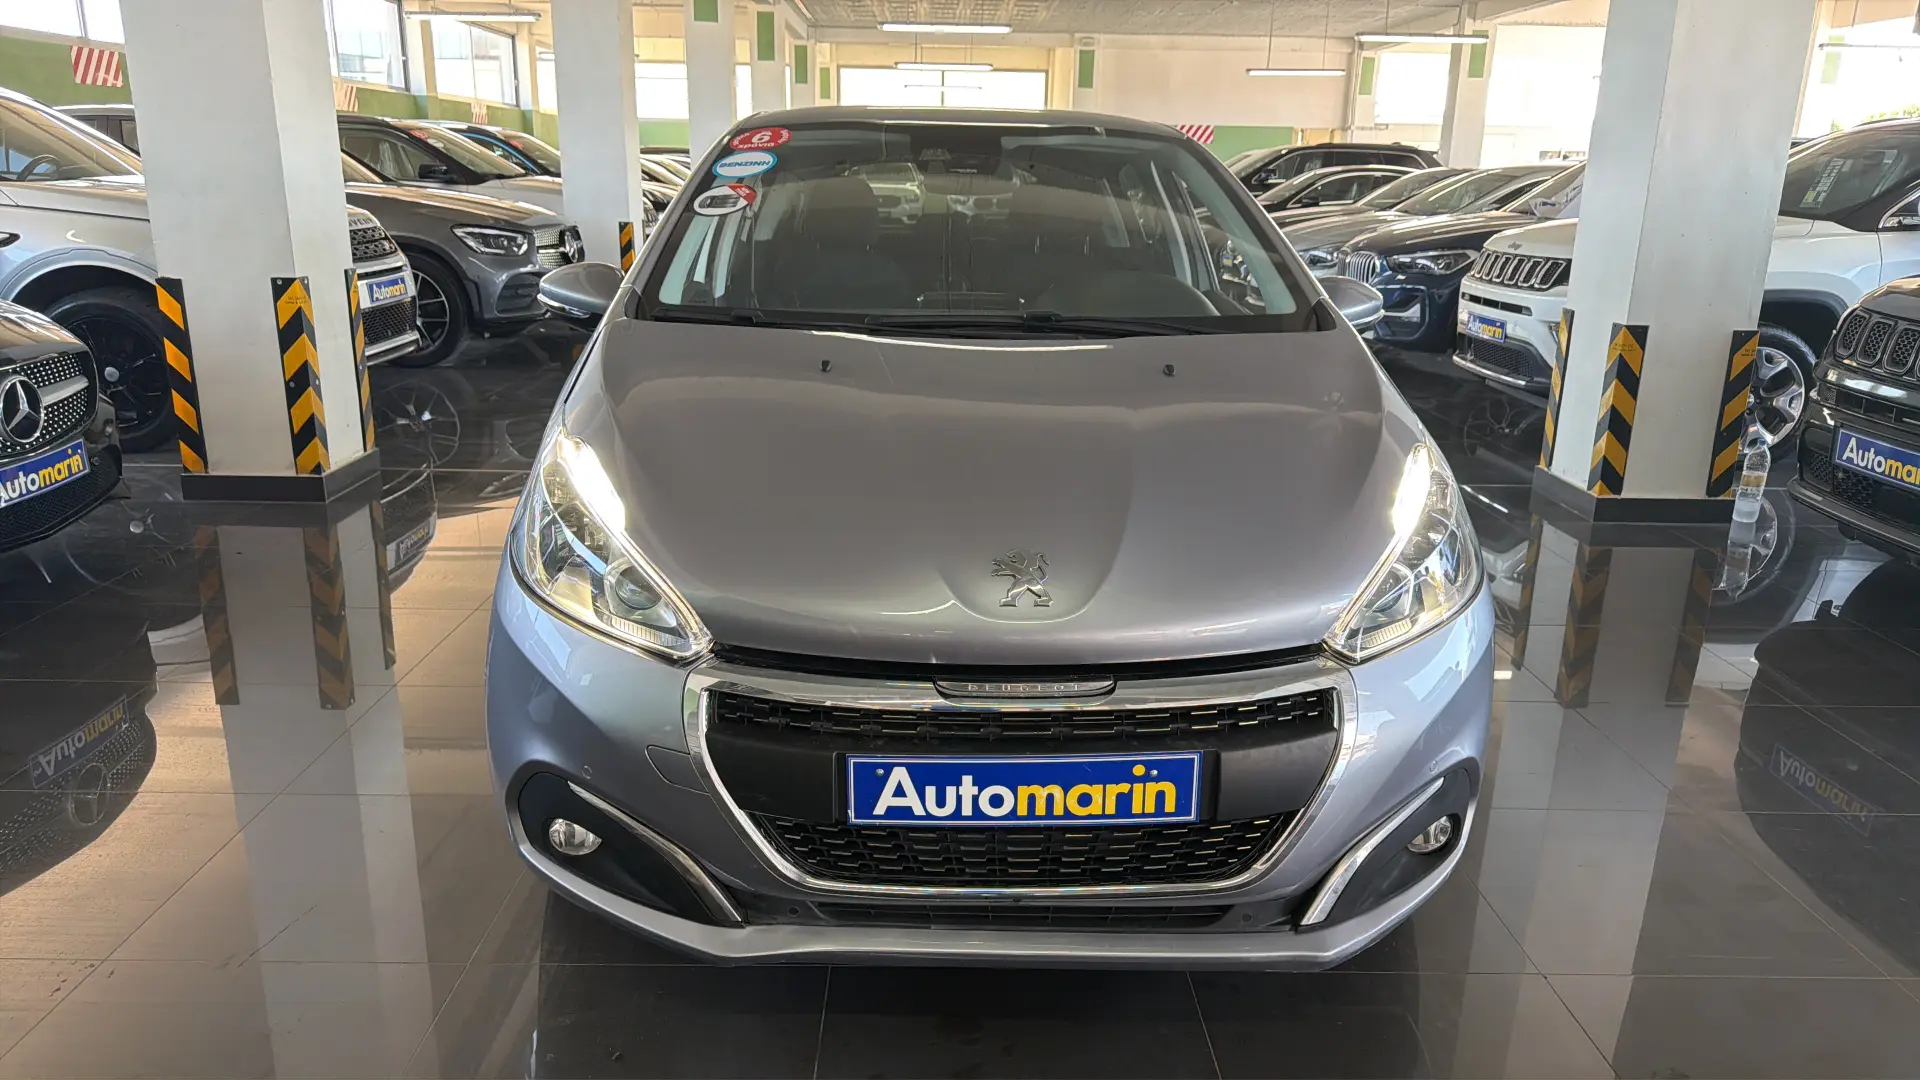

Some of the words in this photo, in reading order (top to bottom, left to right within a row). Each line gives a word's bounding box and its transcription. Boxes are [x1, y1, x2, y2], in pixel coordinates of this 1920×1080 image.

[751, 130, 773, 144] 6
[967, 683, 1080, 692] PEUGEOT
[873, 763, 1176, 817] Automarin
